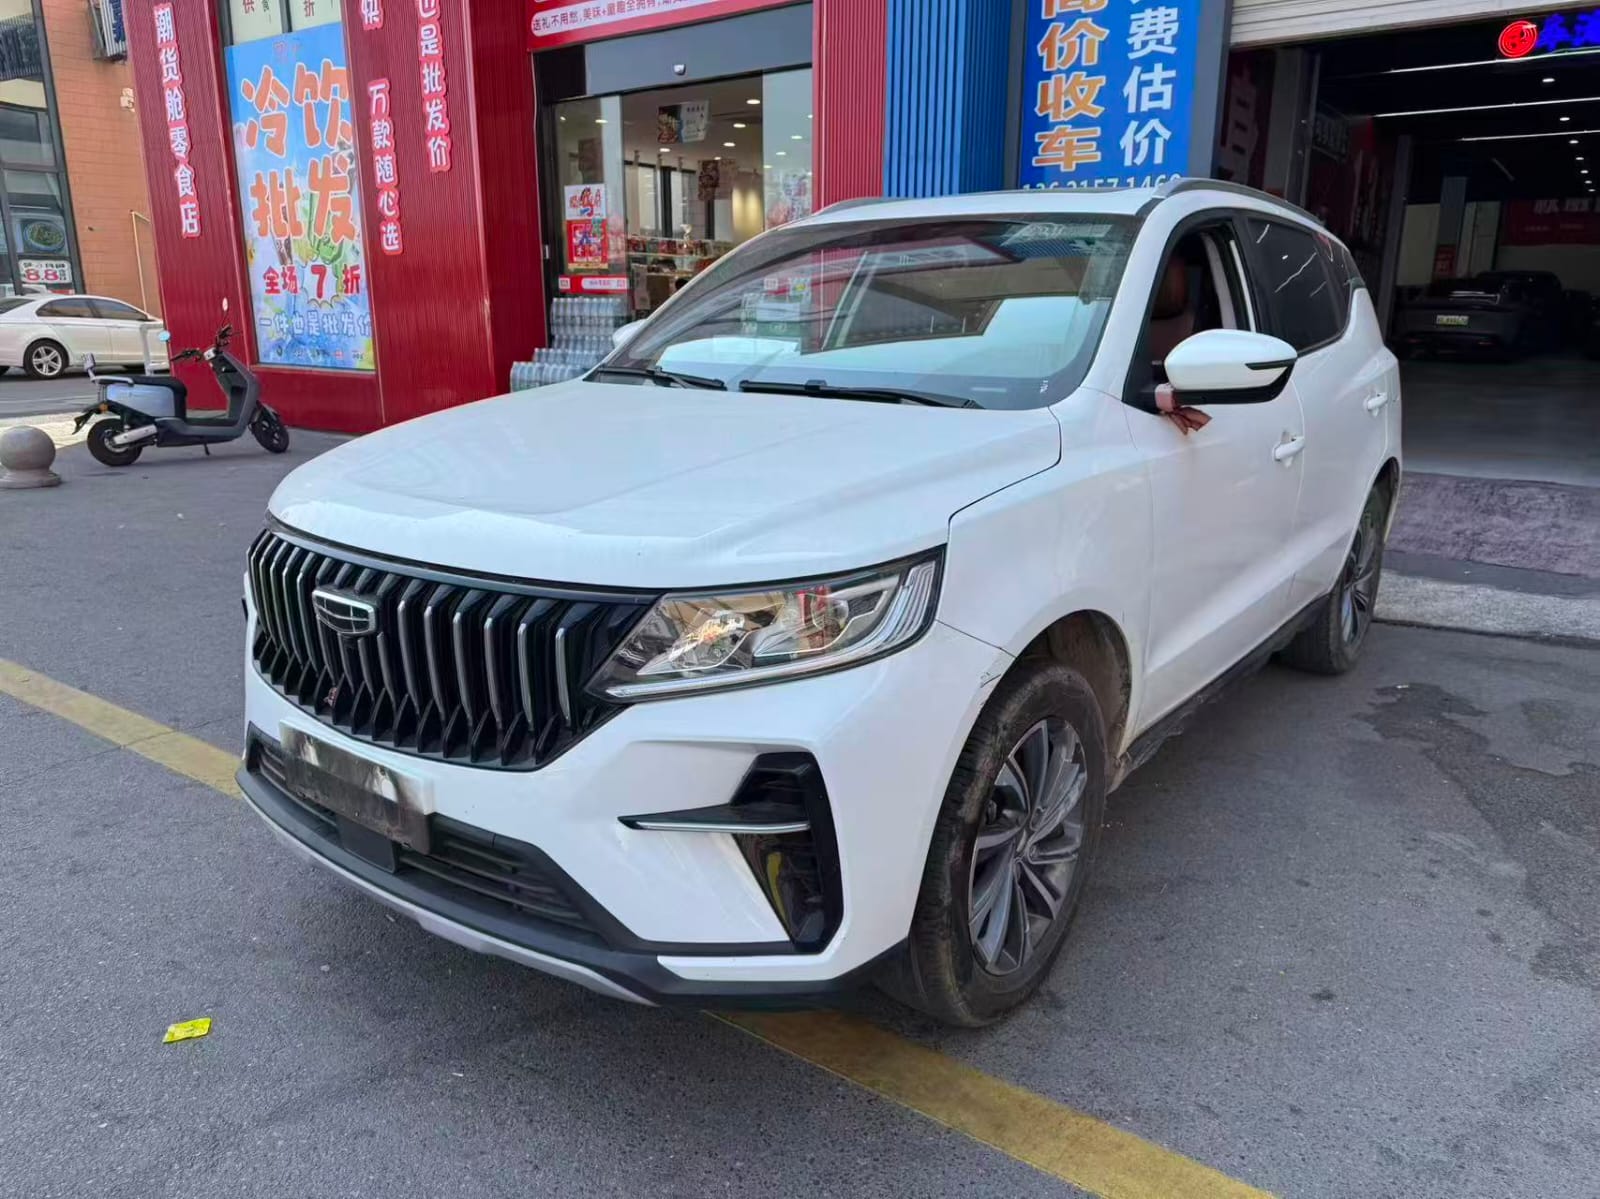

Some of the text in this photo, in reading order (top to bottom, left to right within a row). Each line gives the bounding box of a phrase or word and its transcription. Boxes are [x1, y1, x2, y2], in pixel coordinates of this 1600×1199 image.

[154, 6, 199, 235] 潮货舱零食店
[240, 58, 353, 158] 冷饮
[1119, 0, 1179, 167] 费估价
[249, 154, 357, 246] 批发
[368, 83, 400, 251] 万款随心选
[259, 309, 371, 338] 一件也是批发价
